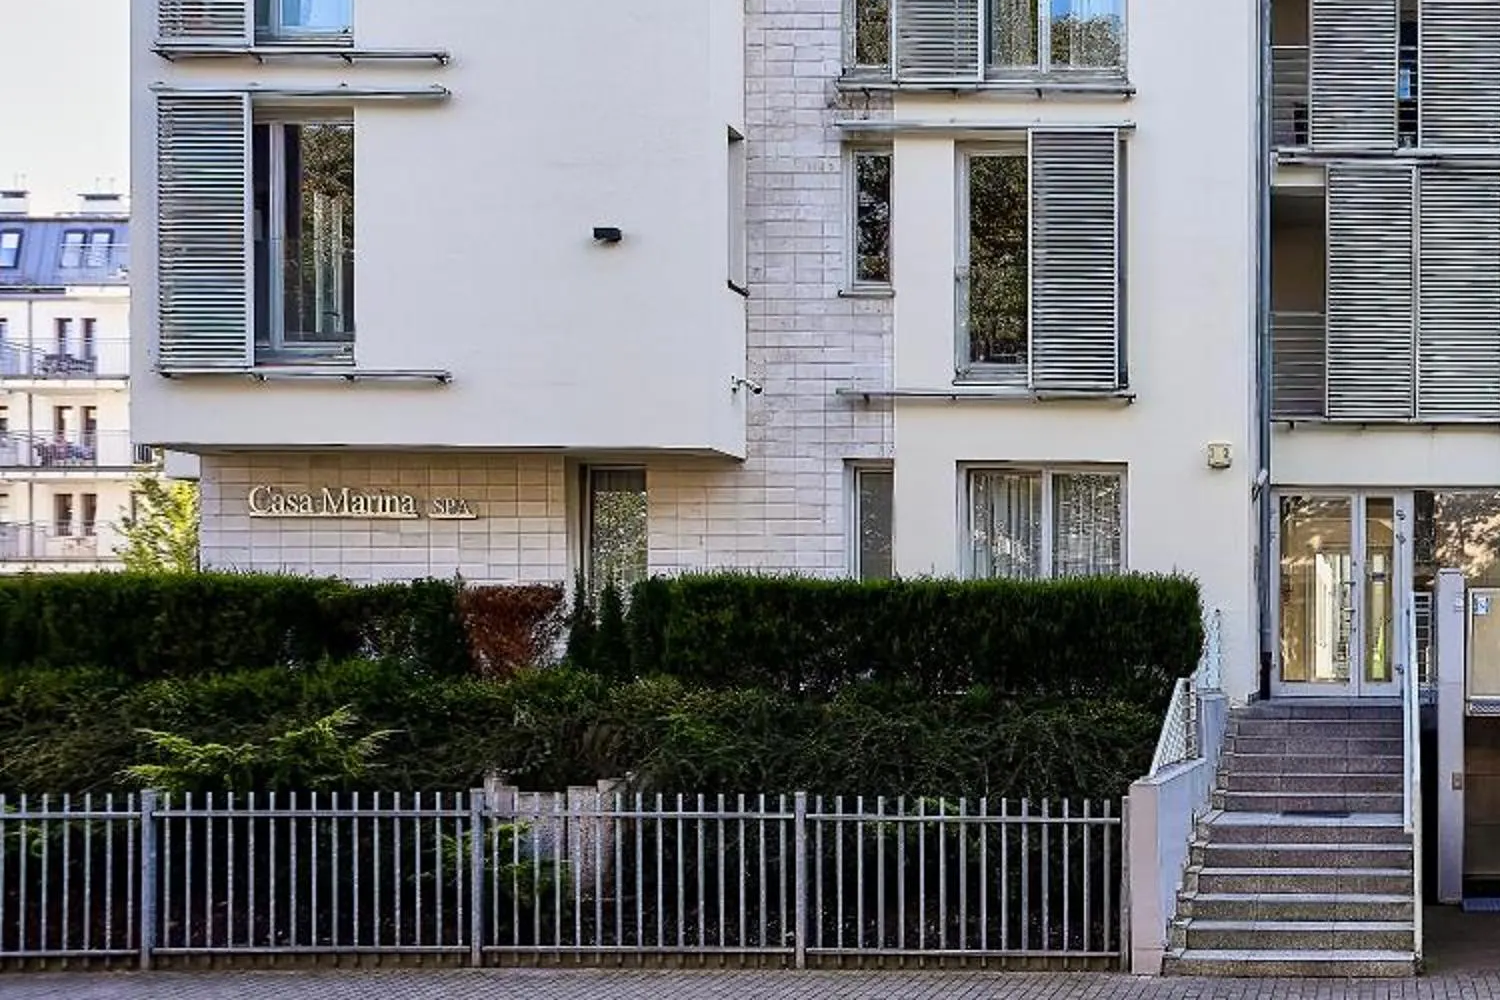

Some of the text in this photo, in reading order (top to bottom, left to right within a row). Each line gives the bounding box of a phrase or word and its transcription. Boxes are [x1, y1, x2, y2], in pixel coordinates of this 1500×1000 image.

[249, 485, 473, 515] Casa Marina SPA
